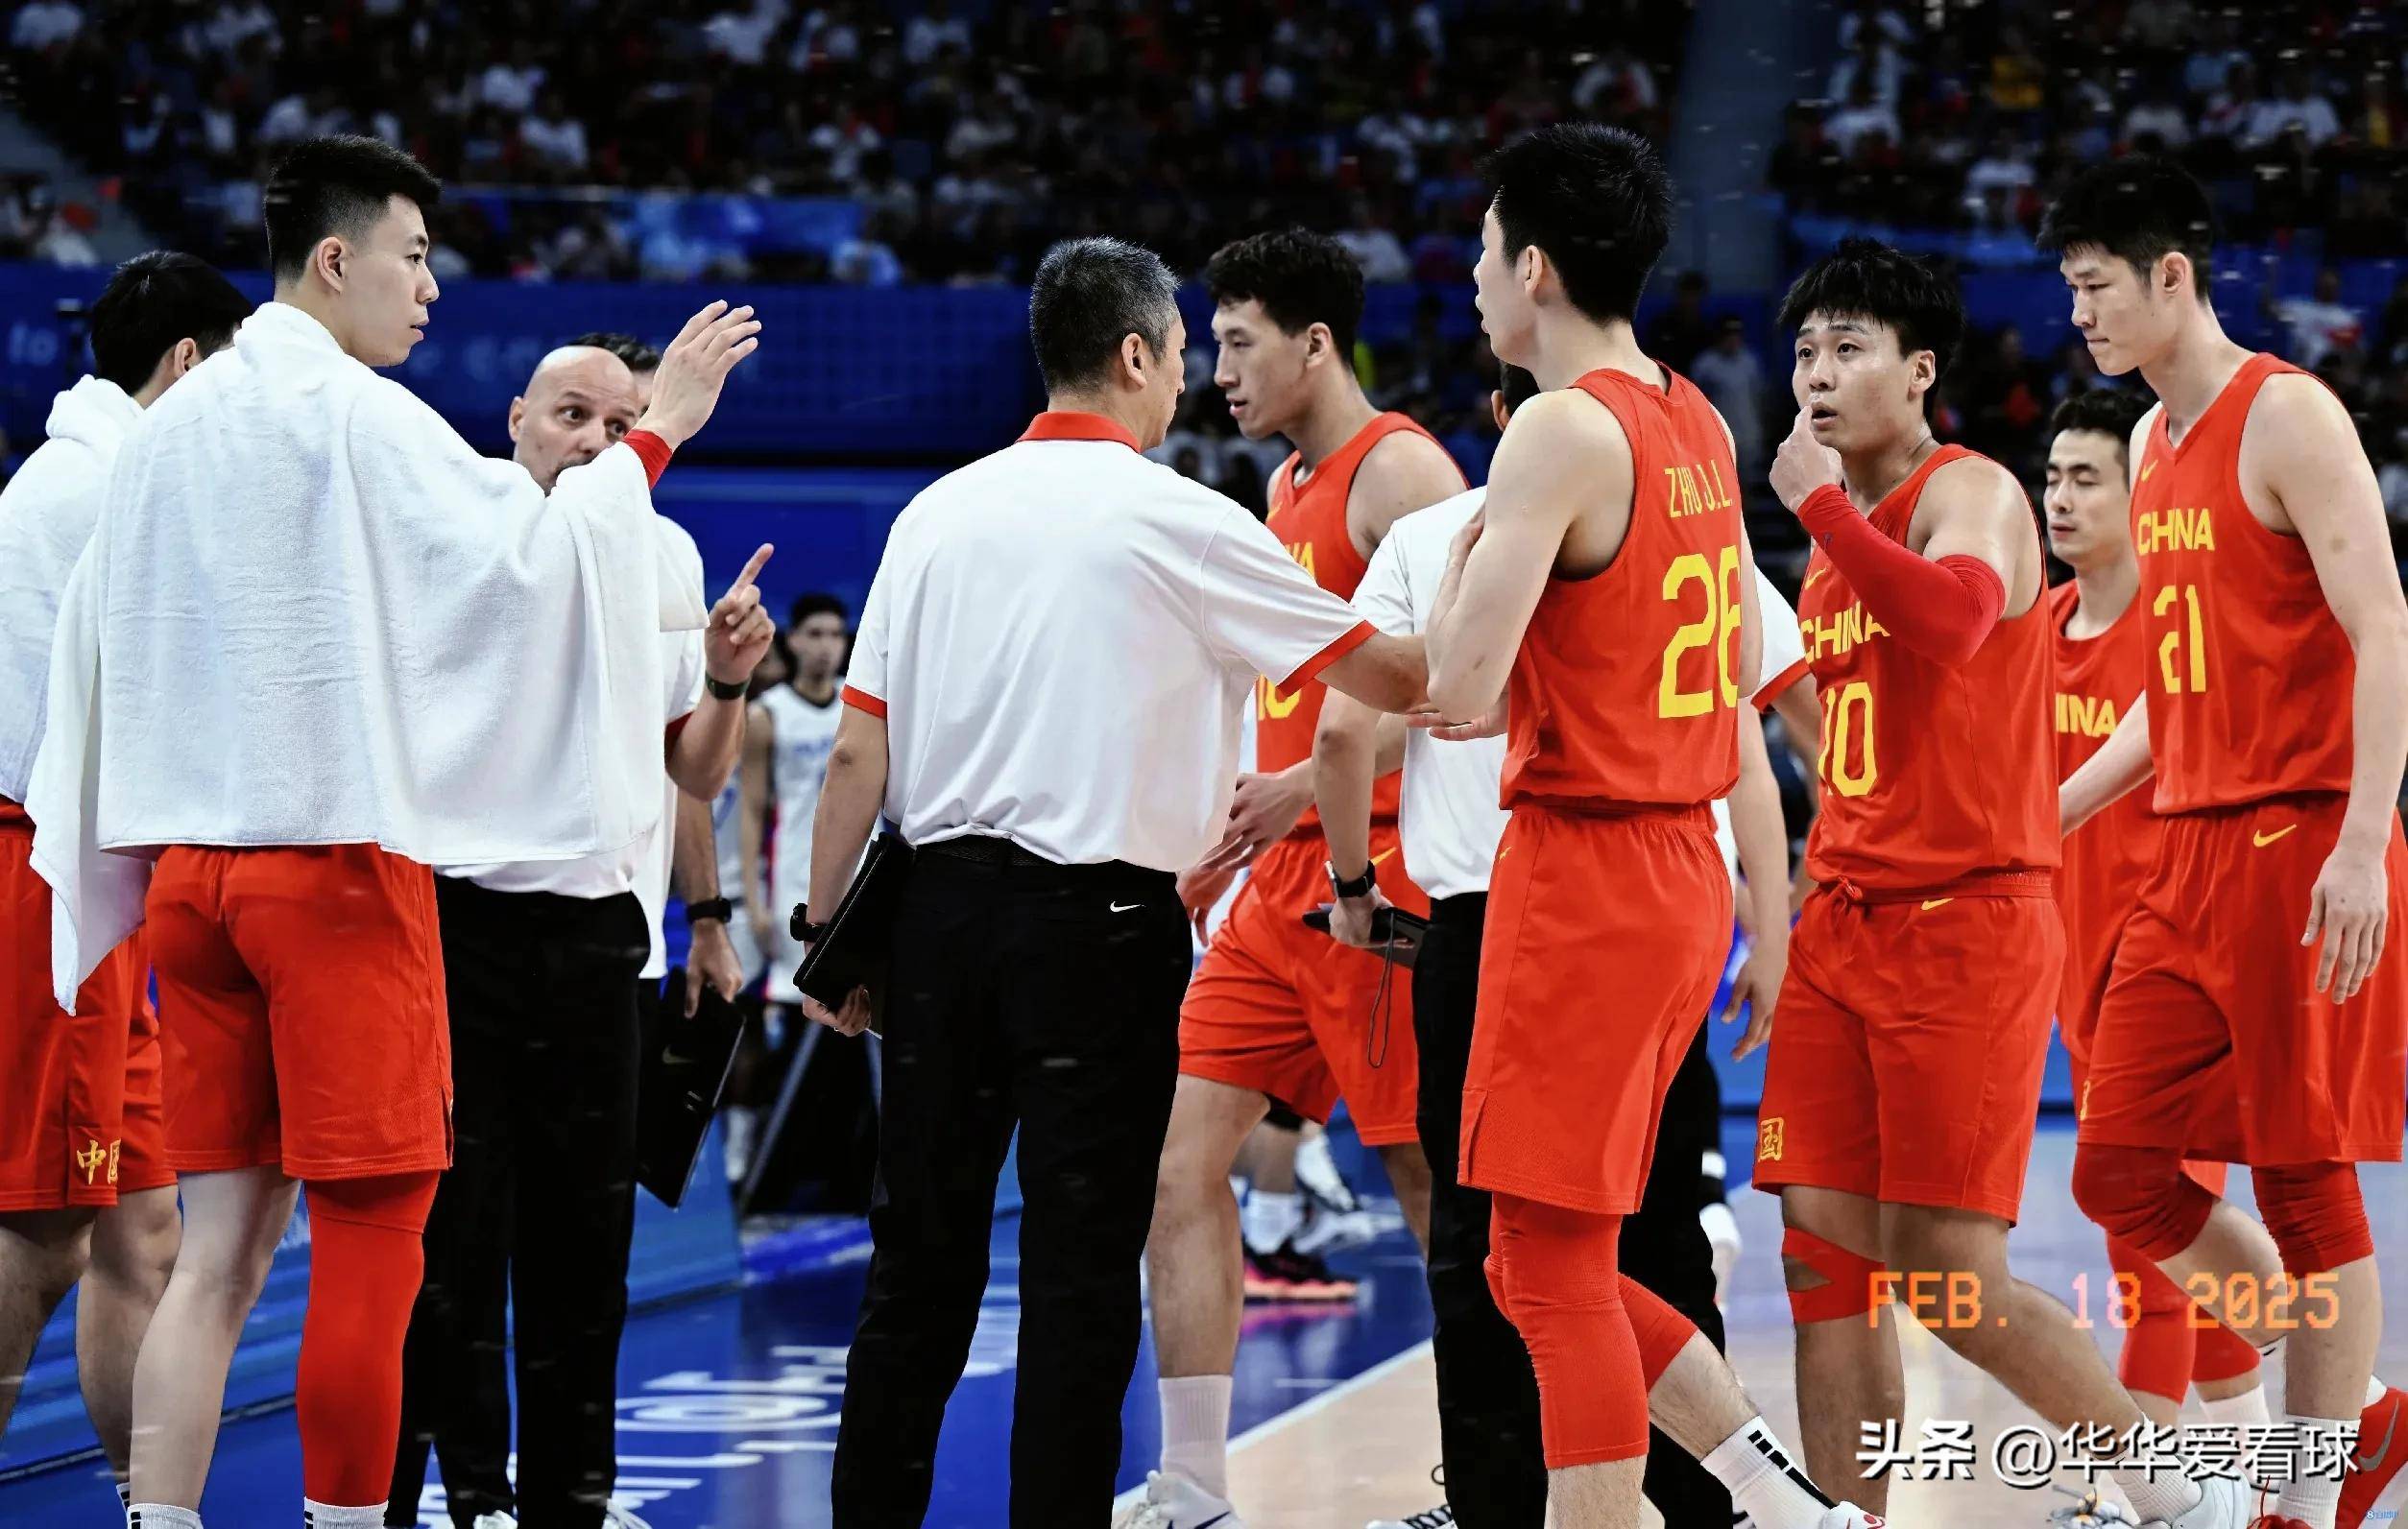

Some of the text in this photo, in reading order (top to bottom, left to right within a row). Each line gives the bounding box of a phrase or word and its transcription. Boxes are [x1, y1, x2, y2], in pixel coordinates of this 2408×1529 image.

[1664, 466, 1703, 518] ZHU
[2137, 507, 2216, 557] CHNA
[1659, 545, 1741, 718] 26
[1800, 599, 1891, 665] CHINA
[2153, 585, 2206, 694] 21
[1818, 681, 1878, 798] 10
[2055, 691, 2119, 738] INA
